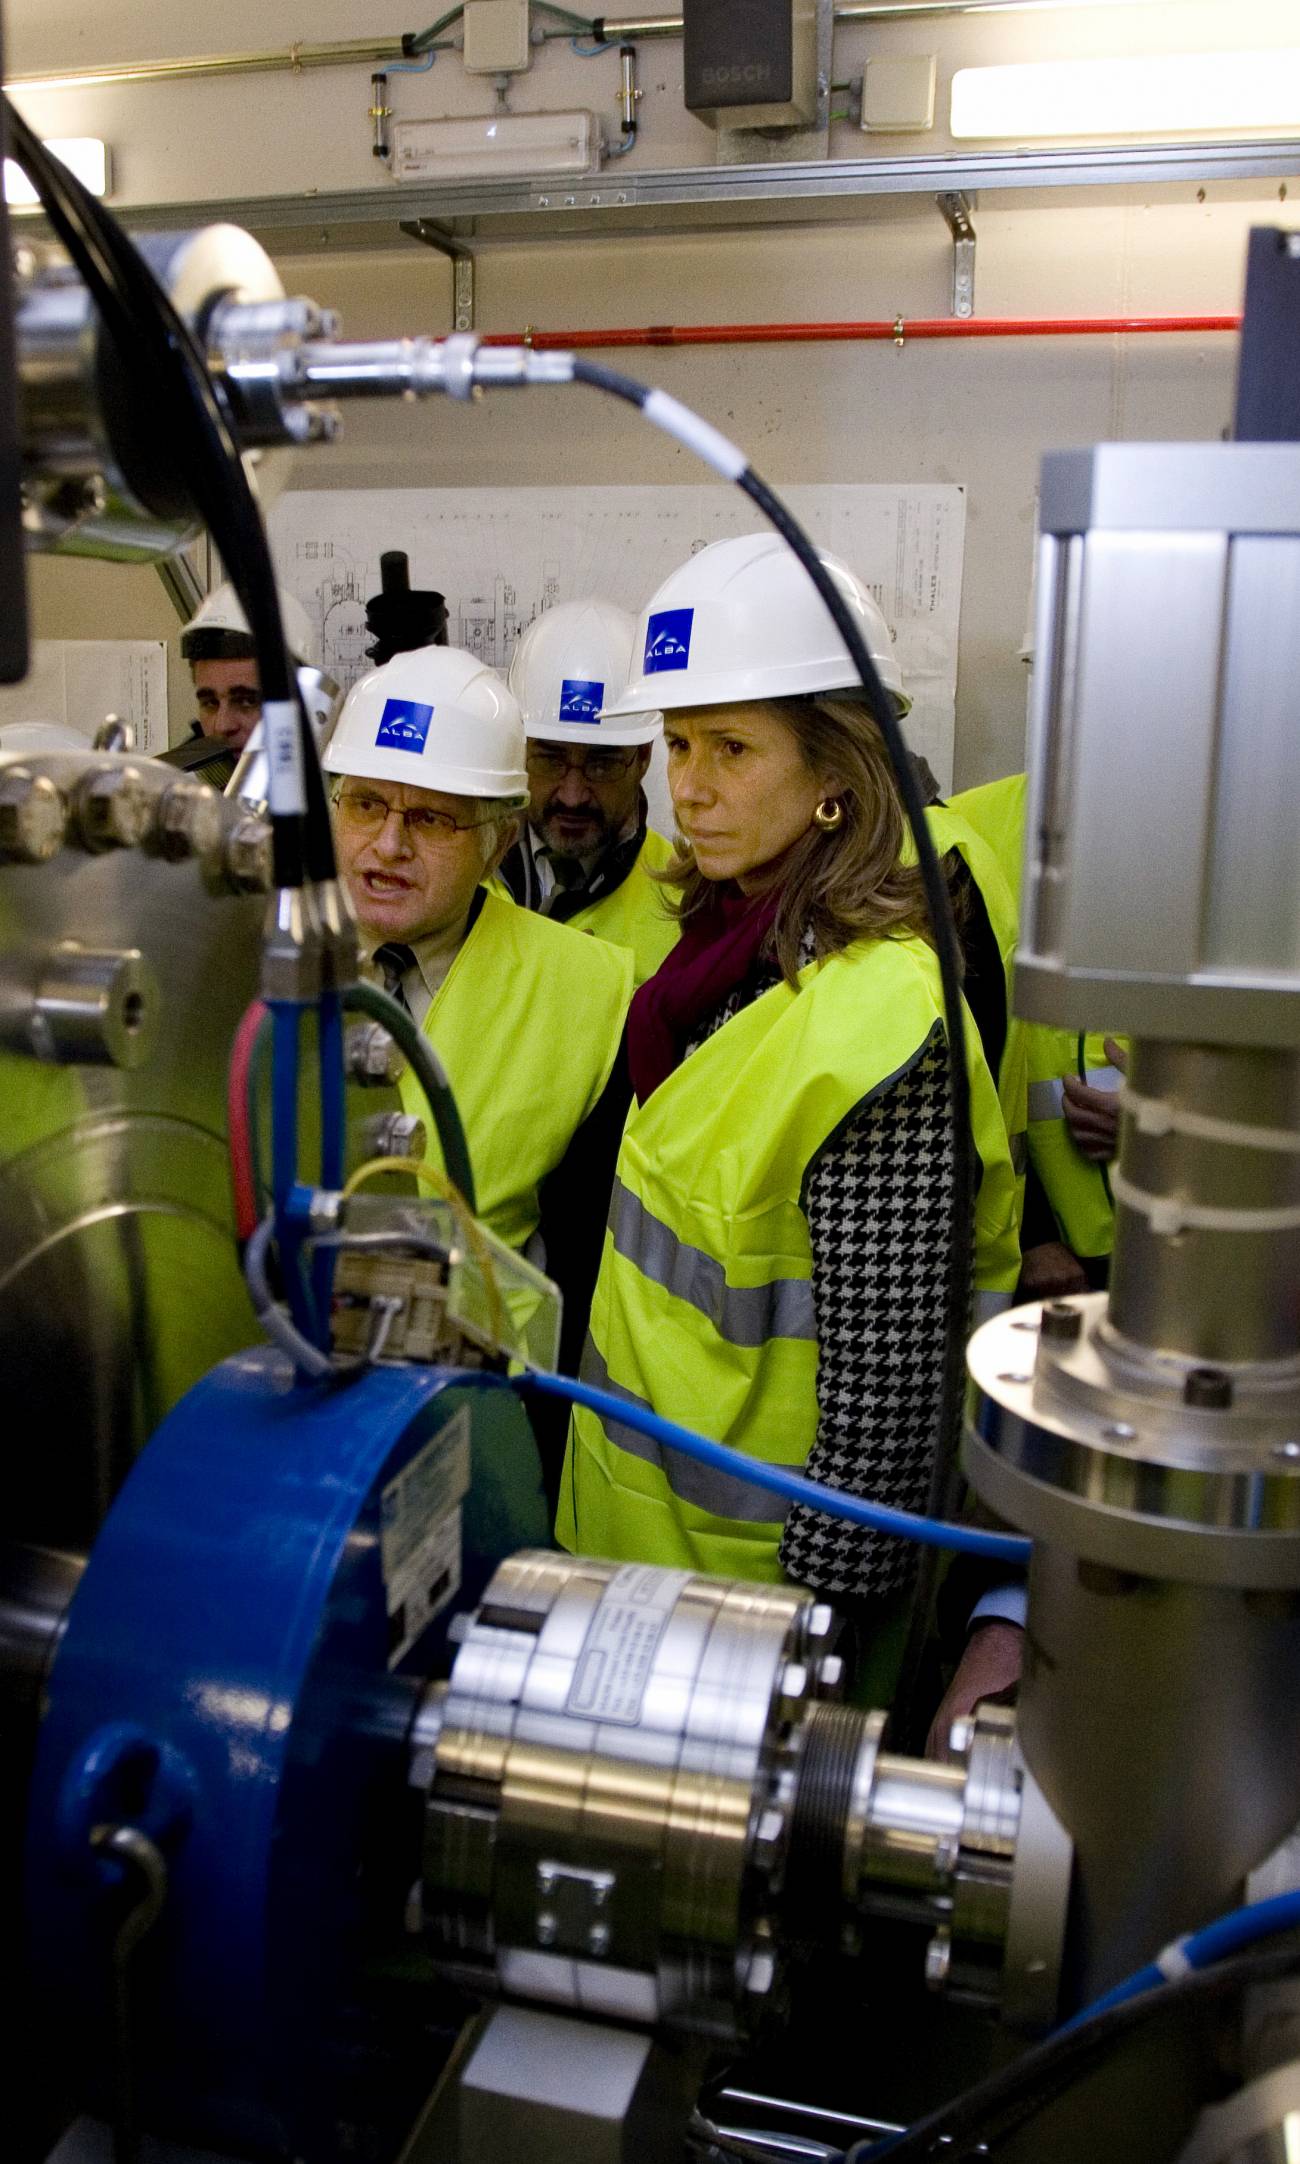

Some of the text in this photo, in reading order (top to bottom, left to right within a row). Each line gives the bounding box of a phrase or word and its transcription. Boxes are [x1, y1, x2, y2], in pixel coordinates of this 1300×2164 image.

[702, 65, 769, 82] BOSCH
[646, 645, 687, 658] ALBA
[562, 704, 600, 712] ALBA
[380, 727, 424, 741] ALBA
